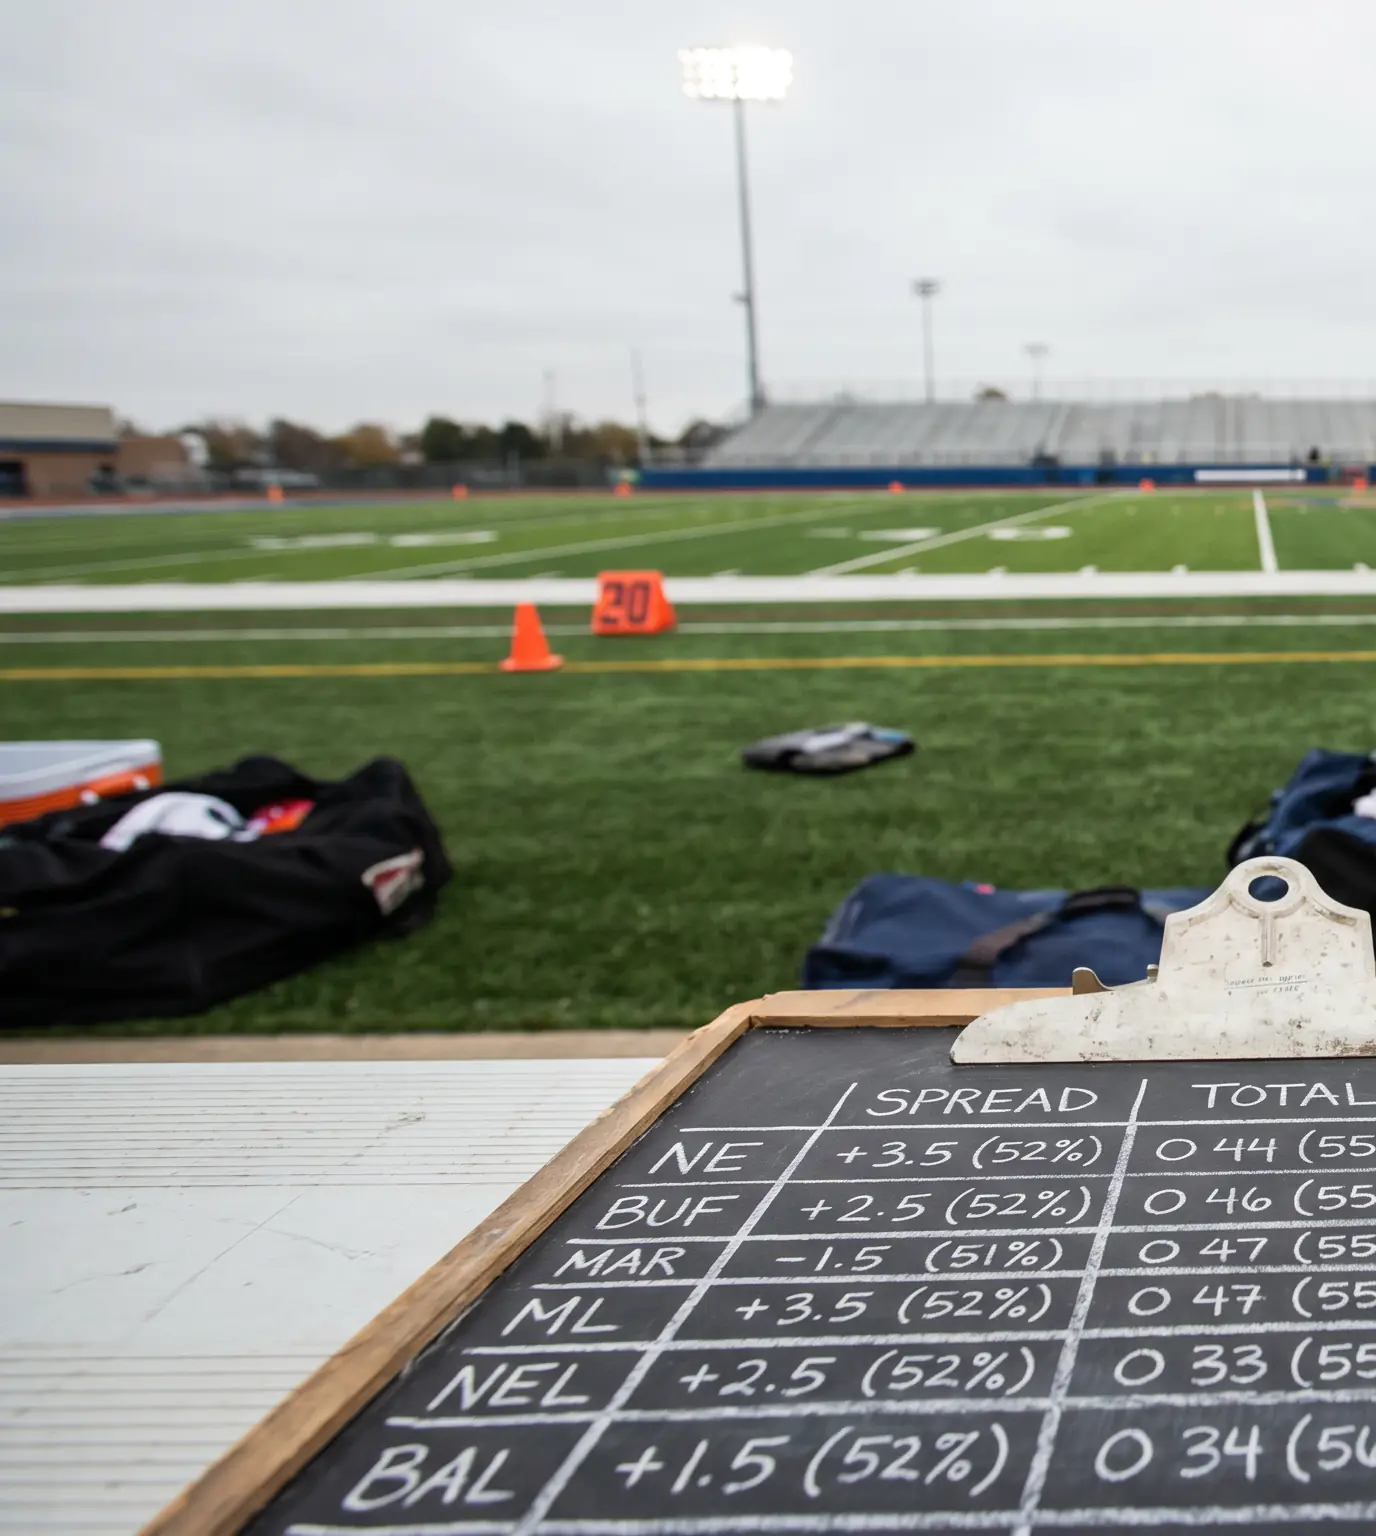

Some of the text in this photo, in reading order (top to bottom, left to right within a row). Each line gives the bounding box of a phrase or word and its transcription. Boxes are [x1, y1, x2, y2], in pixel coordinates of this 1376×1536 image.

[865, 1087, 1098, 1116] SPREAD
[648, 1141, 764, 1175] NE
[836, 1141, 959, 1167] +3.5
[972, 1135, 1102, 1169] (52%)
[1213, 1138, 1278, 1162] 44
[595, 1195, 740, 1230] BUF
[800, 1193, 932, 1222] +2.5
[945, 1186, 1091, 1225] (52%)
[1205, 1187, 1272, 1214] 46
[553, 1247, 686, 1277] MAR
[776, 1245, 891, 1271] -1.5
[924, 1239, 1064, 1272] (51%)
[1199, 1237, 1268, 1263] 47
[501, 1296, 619, 1336] ML
[735, 1291, 874, 1325] +3.5
[897, 1284, 1051, 1324] (52%)
[1192, 1284, 1266, 1316] 47
[427, 1362, 589, 1411] NEL
[679, 1357, 837, 1397] +2.5
[861, 1345, 1036, 1397] (52%)
[1191, 1344, 1267, 1386] 33
[343, 1444, 513, 1511] BAL
[616, 1435, 790, 1494] +1.5
[804, 1423, 1009, 1497] (52%)
[1180, 1425, 1264, 1480] 34
